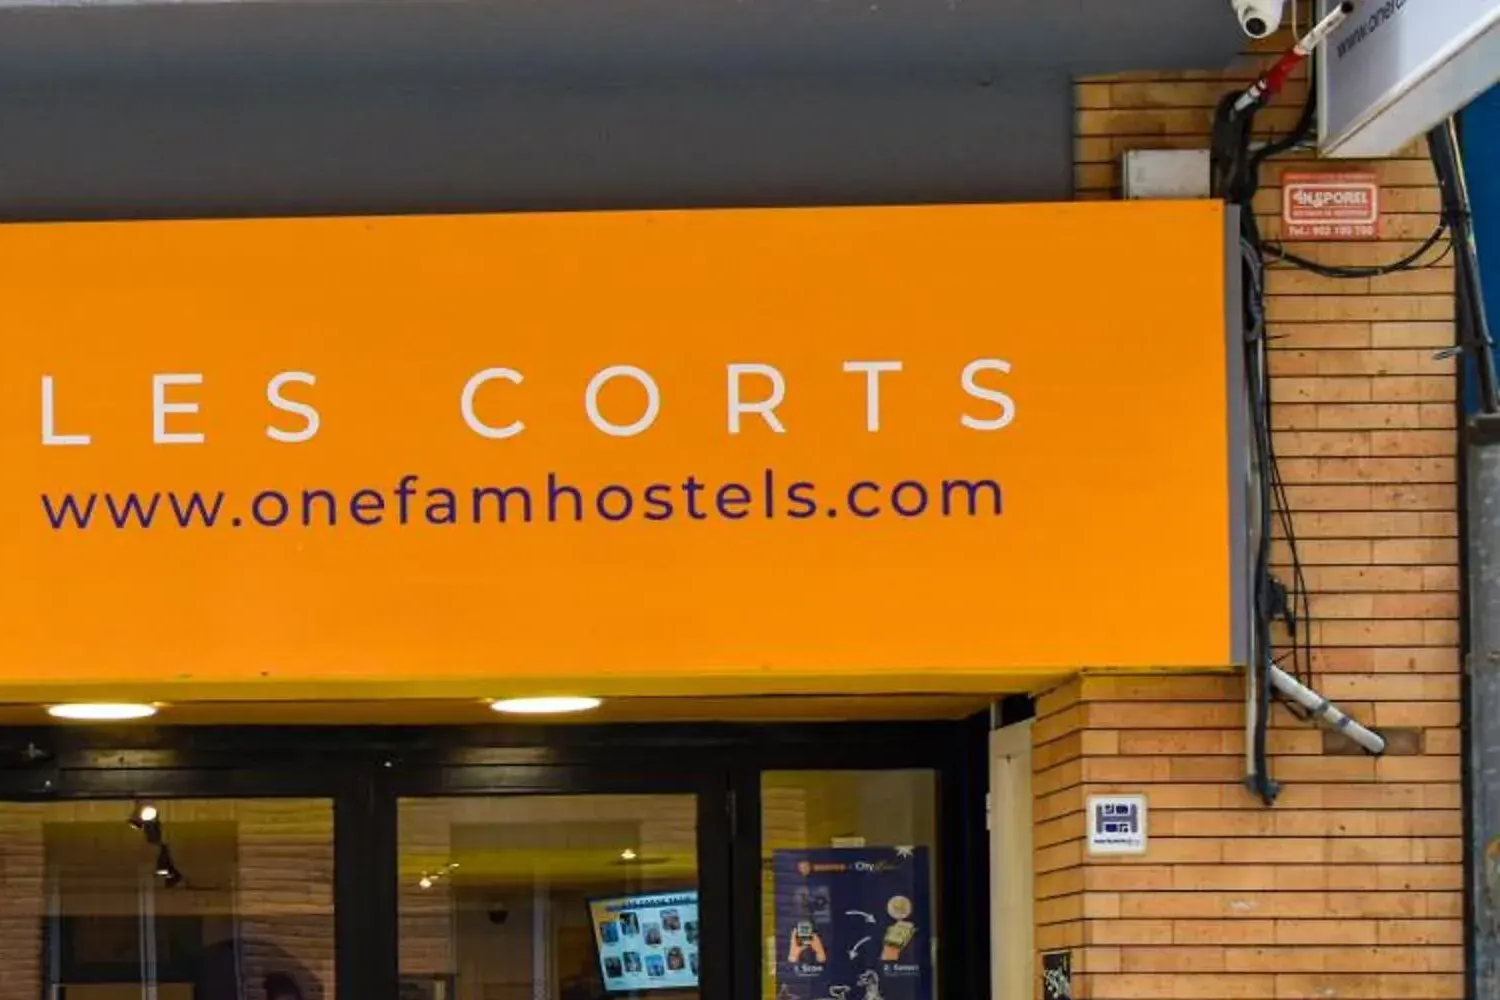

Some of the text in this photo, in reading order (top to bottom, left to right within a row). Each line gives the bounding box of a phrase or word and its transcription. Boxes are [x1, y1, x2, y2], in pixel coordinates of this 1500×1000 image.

[42, 359, 1016, 447] LES CORTS
[41, 468, 1003, 529] www.onefamhostels.com
